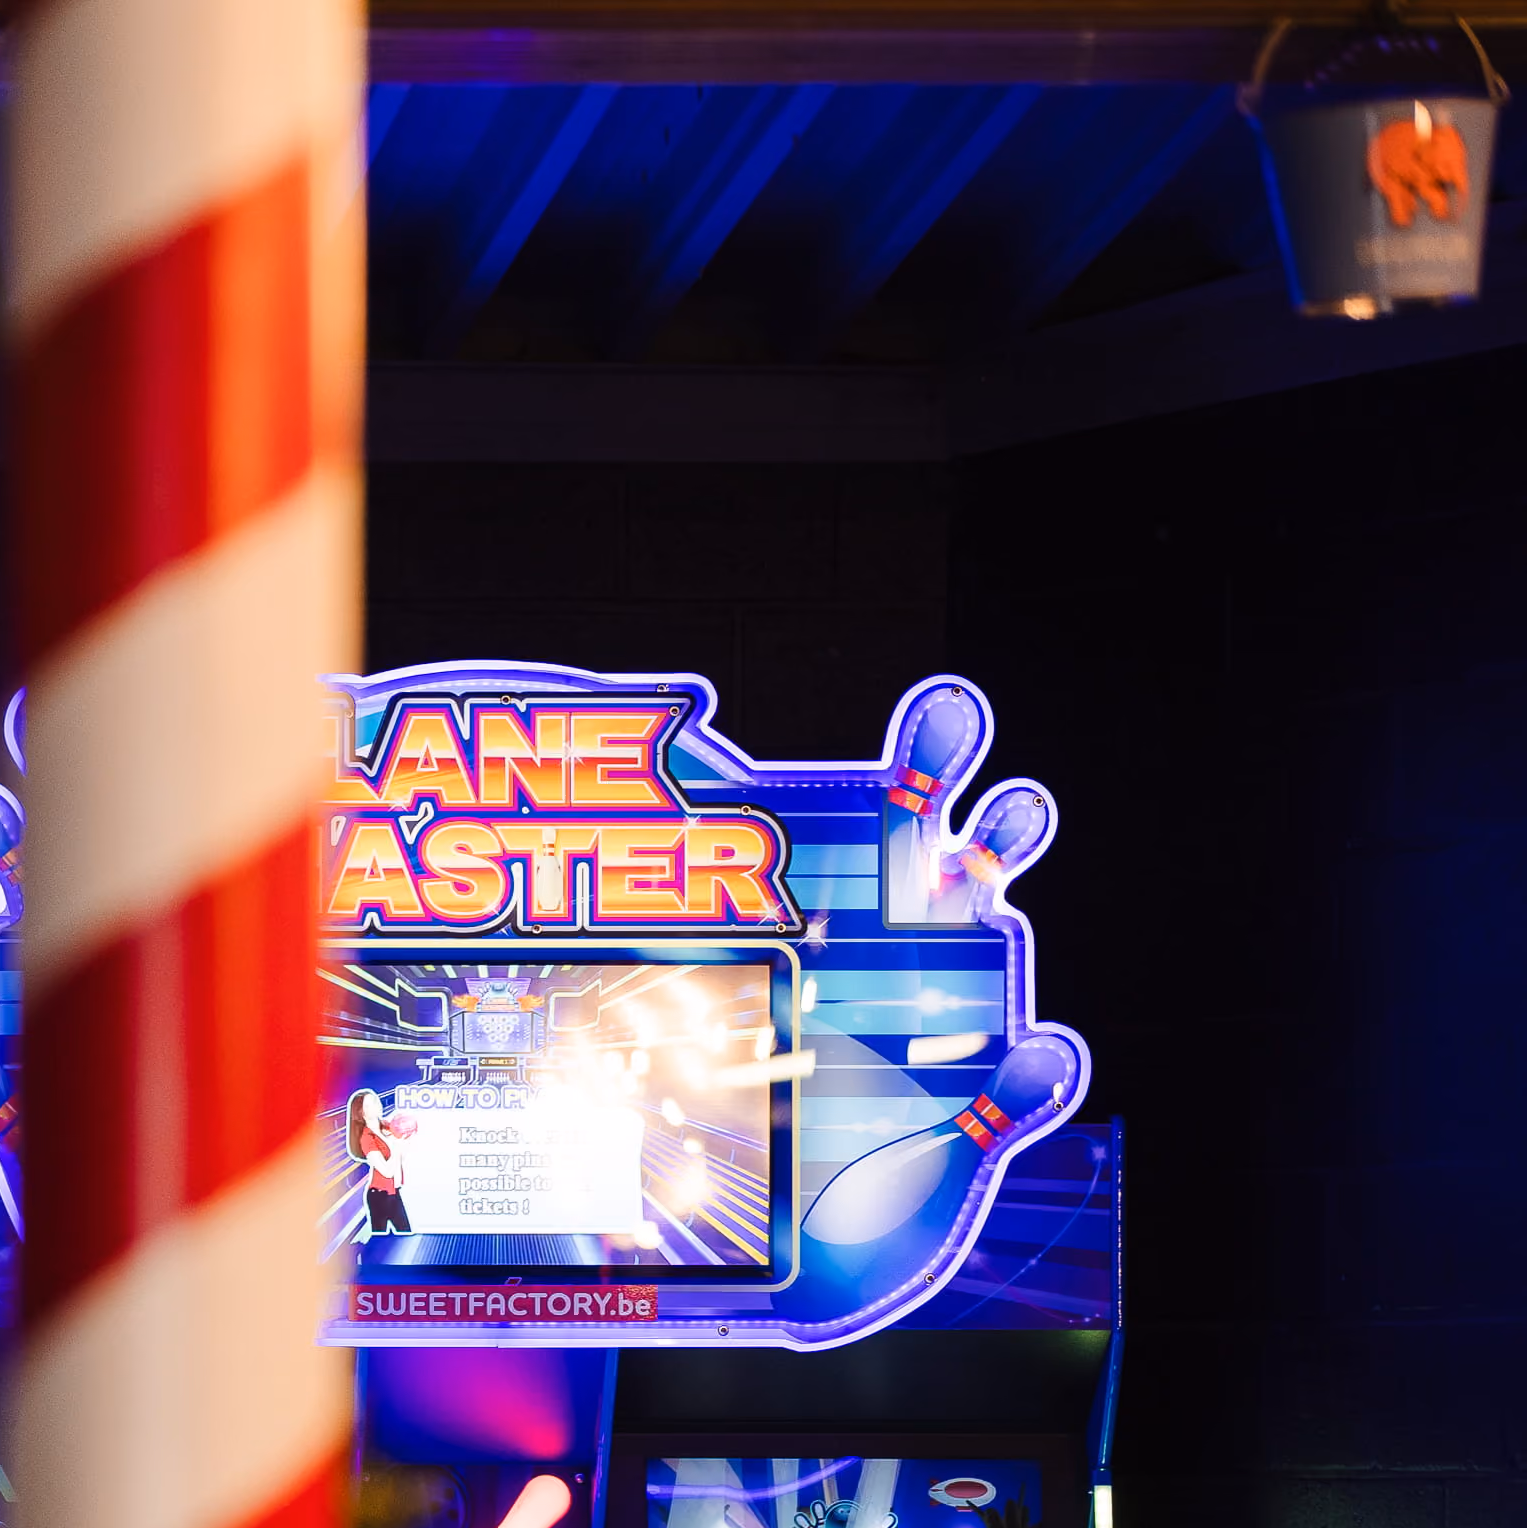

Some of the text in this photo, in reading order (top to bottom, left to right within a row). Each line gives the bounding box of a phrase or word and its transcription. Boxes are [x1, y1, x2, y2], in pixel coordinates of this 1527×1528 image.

[321, 821, 785, 921] ASTER
[397, 1086, 457, 1109] HOW
[461, 1087, 497, 1108] TO
[459, 1127, 518, 1144] Knock
[459, 1154, 511, 1171] many
[459, 1175, 552, 1195] possible to
[459, 1199, 519, 1215] tickets
[356, 1292, 651, 1316] SWEETFACTORY.be
